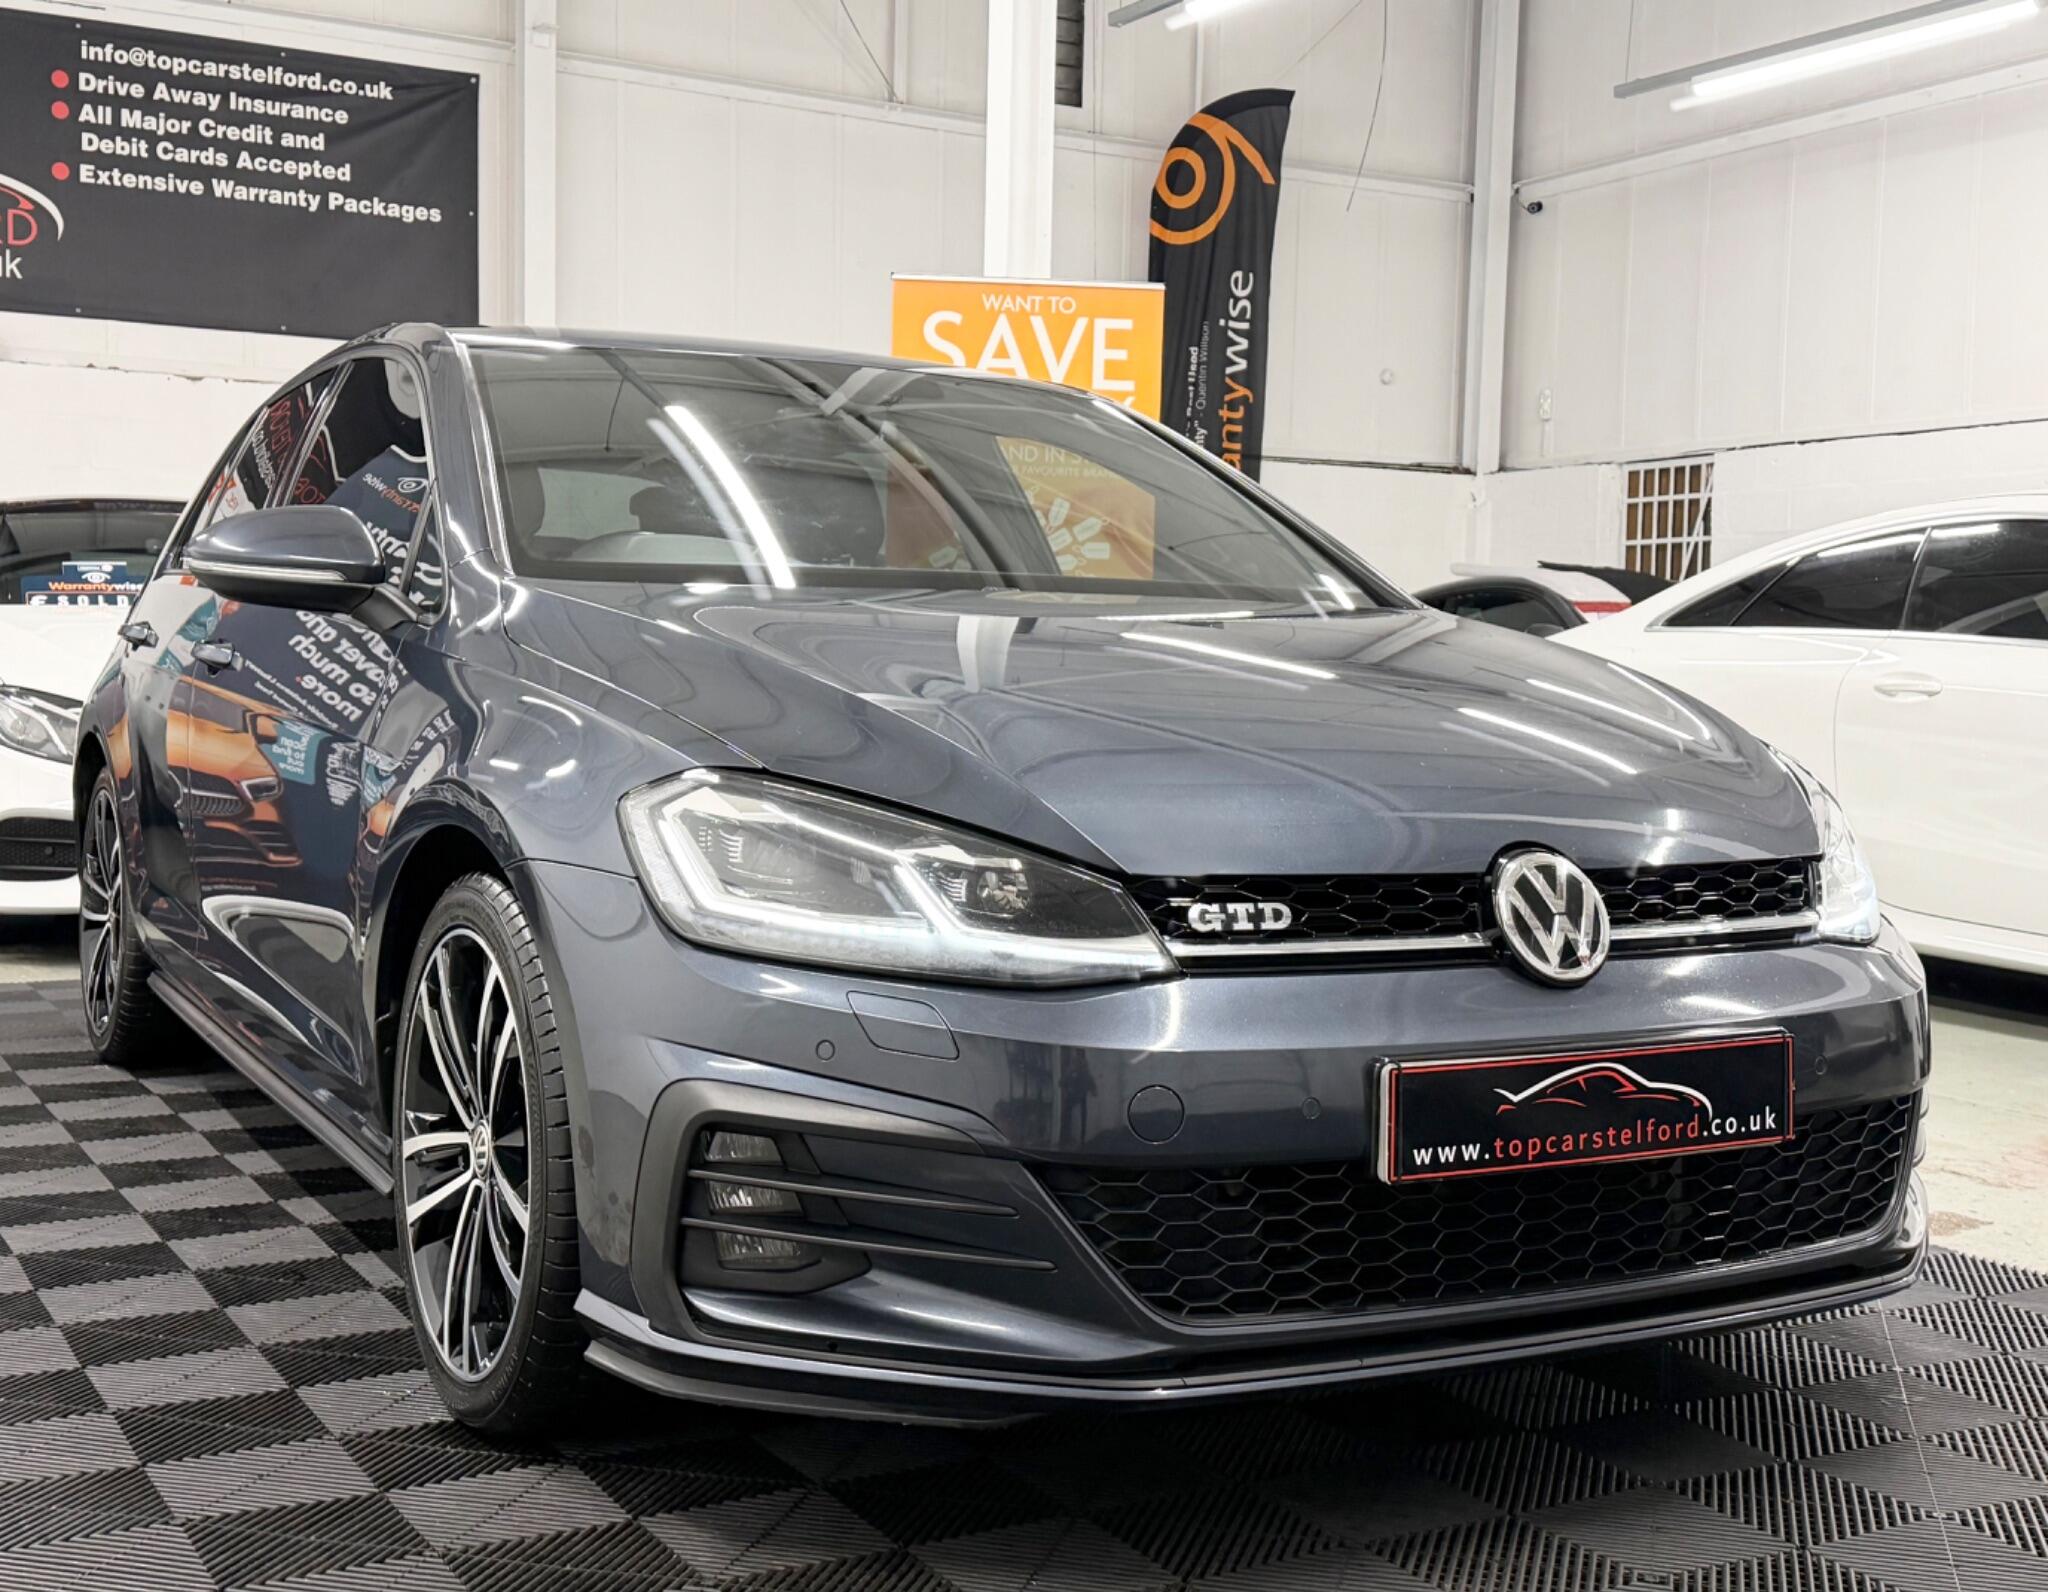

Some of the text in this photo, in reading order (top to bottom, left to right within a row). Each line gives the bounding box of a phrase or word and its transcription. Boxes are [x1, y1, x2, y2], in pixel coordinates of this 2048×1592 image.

[80, 40, 394, 101] info@topcarstelford.co.uk
[78, 72, 349, 126] Drive Away Insurance
[78, 103, 325, 152] All Major Credit and
[80, 131, 352, 182] Debit Cards Accepted
[79, 163, 442, 224] Extensive Warranty Packages
[982, 294, 1077, 315] WANT TO
[923, 310, 1136, 392] SAVE
[1195, 364, 1207, 410] Quentin
[1187, 901, 1292, 932] GTD
[1413, 1105, 1778, 1166] www.topcarstelford.co.uk
